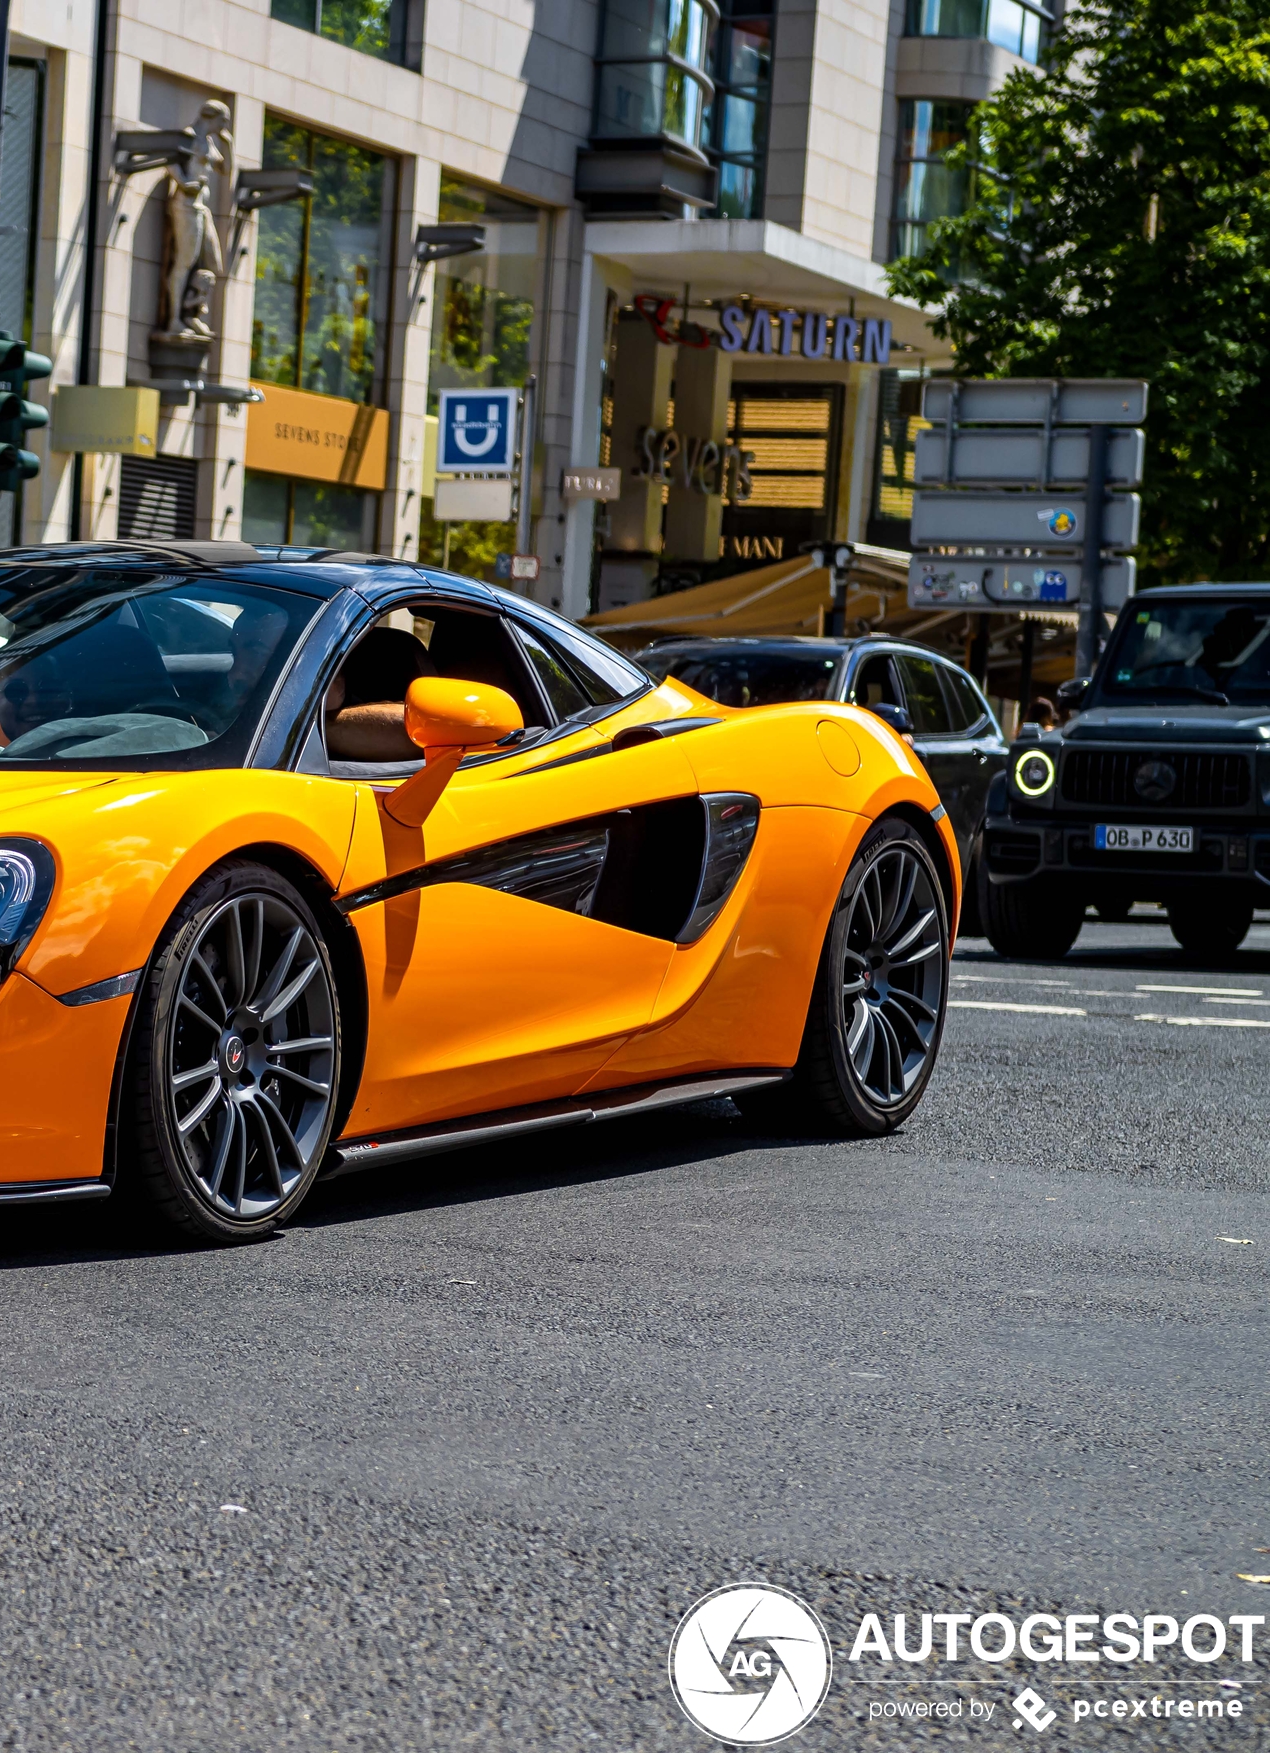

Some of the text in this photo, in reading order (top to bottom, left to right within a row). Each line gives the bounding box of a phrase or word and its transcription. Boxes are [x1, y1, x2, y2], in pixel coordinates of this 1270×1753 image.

[720, 306, 892, 365] SATURN
[275, 422, 320, 446] SEVENS
[1107, 828, 1190, 849] OB P 630
[174, 915, 198, 962] PIRELLI
